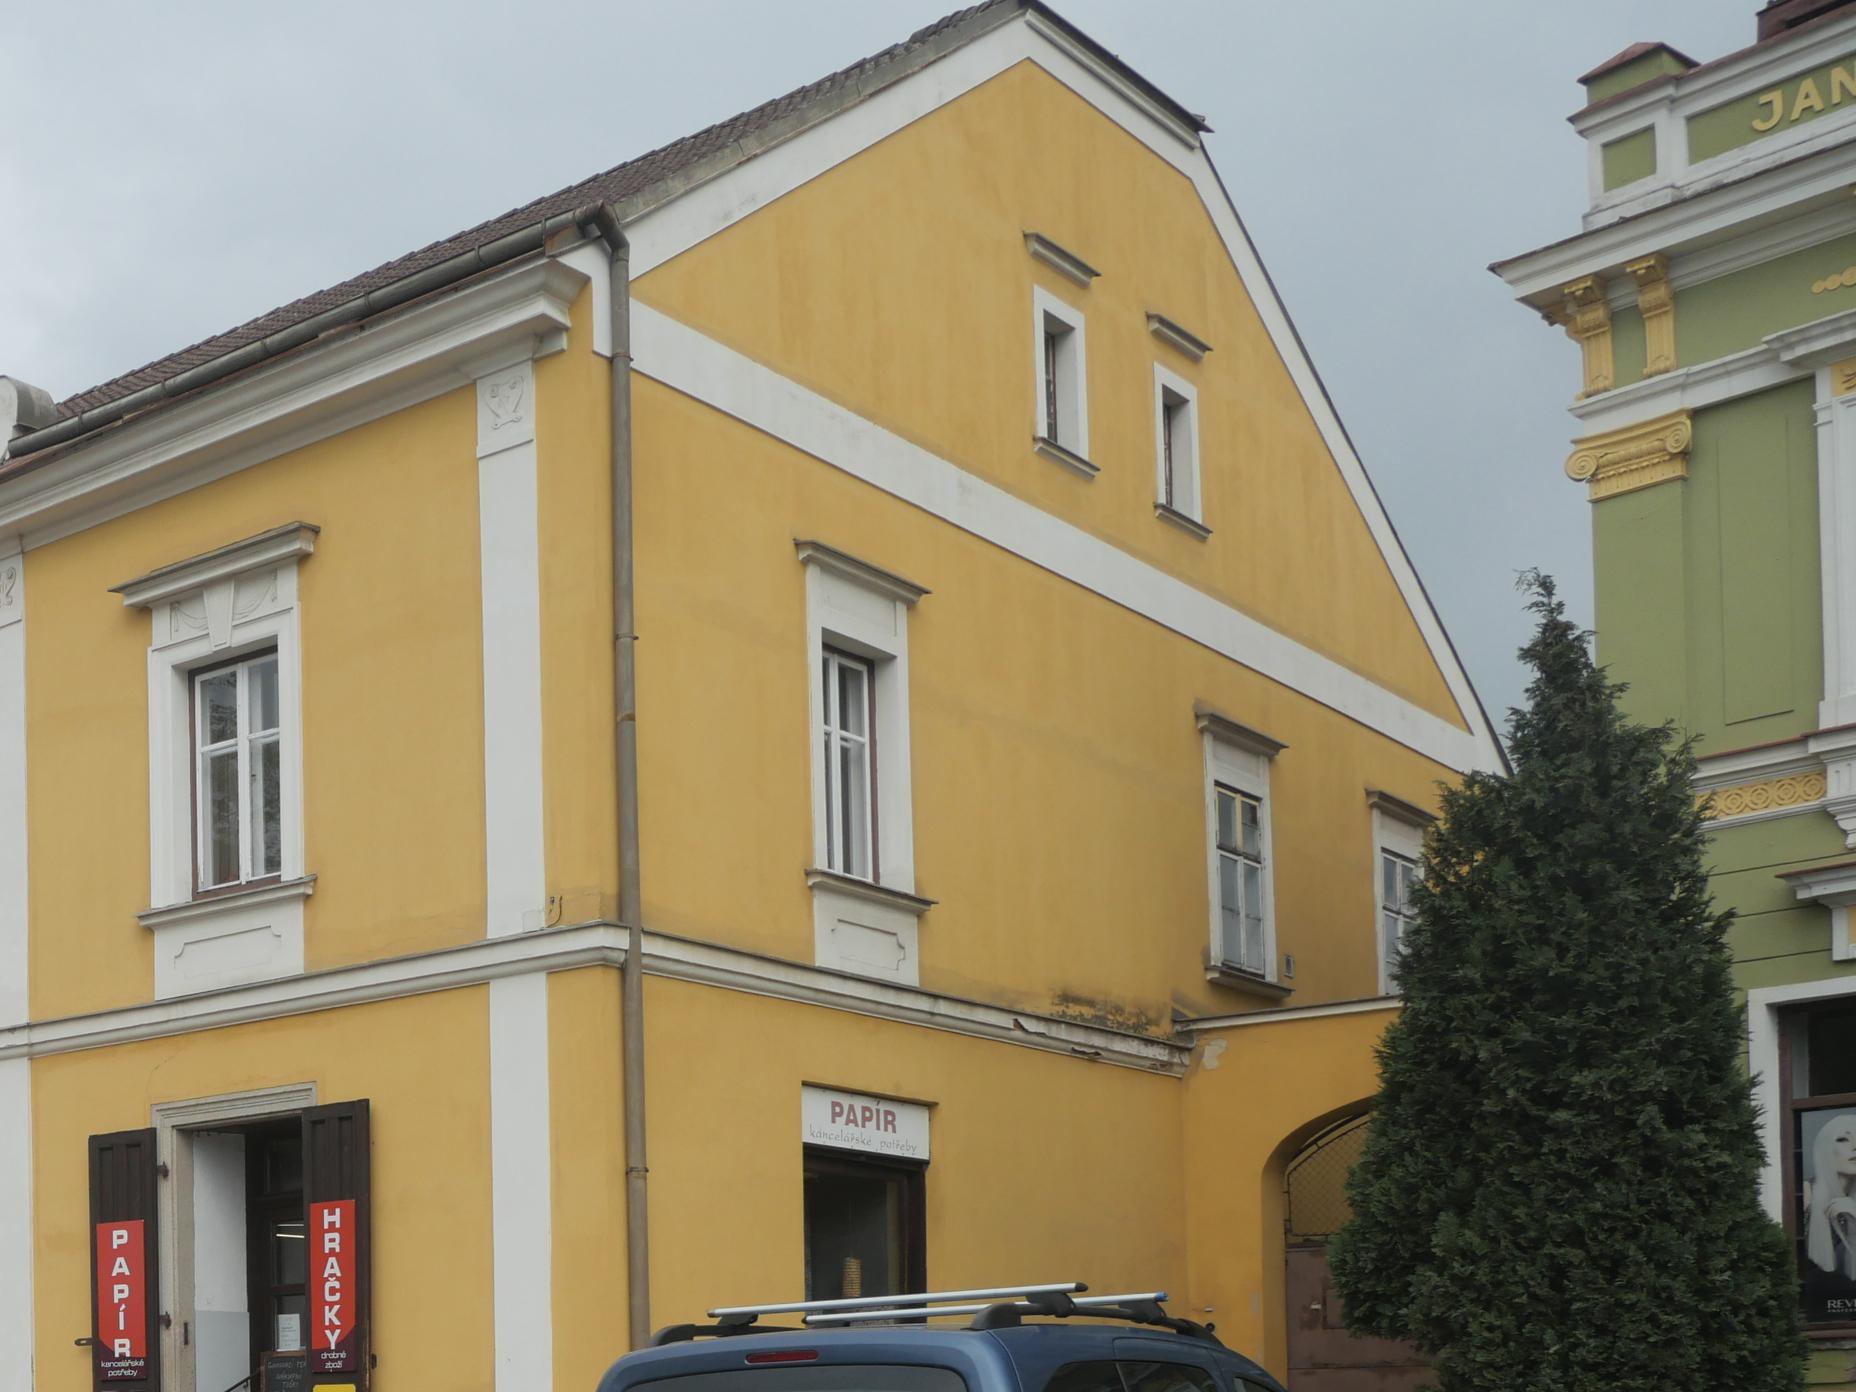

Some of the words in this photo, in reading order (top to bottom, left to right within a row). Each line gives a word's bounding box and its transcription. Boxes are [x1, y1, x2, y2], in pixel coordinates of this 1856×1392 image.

[831, 1100, 897, 1134] PAPÍR
[880, 1138, 918, 1153] potřeby
[323, 1207, 343, 1350] HRAČKY
[112, 1229, 131, 1358] PAPÍR
[1827, 1299, 1856, 1309] REV
[321, 1350, 347, 1360] drobné
[101, 1358, 144, 1369] kancelářské
[325, 1360, 343, 1369] zboží
[108, 1368, 138, 1378] potřeby
